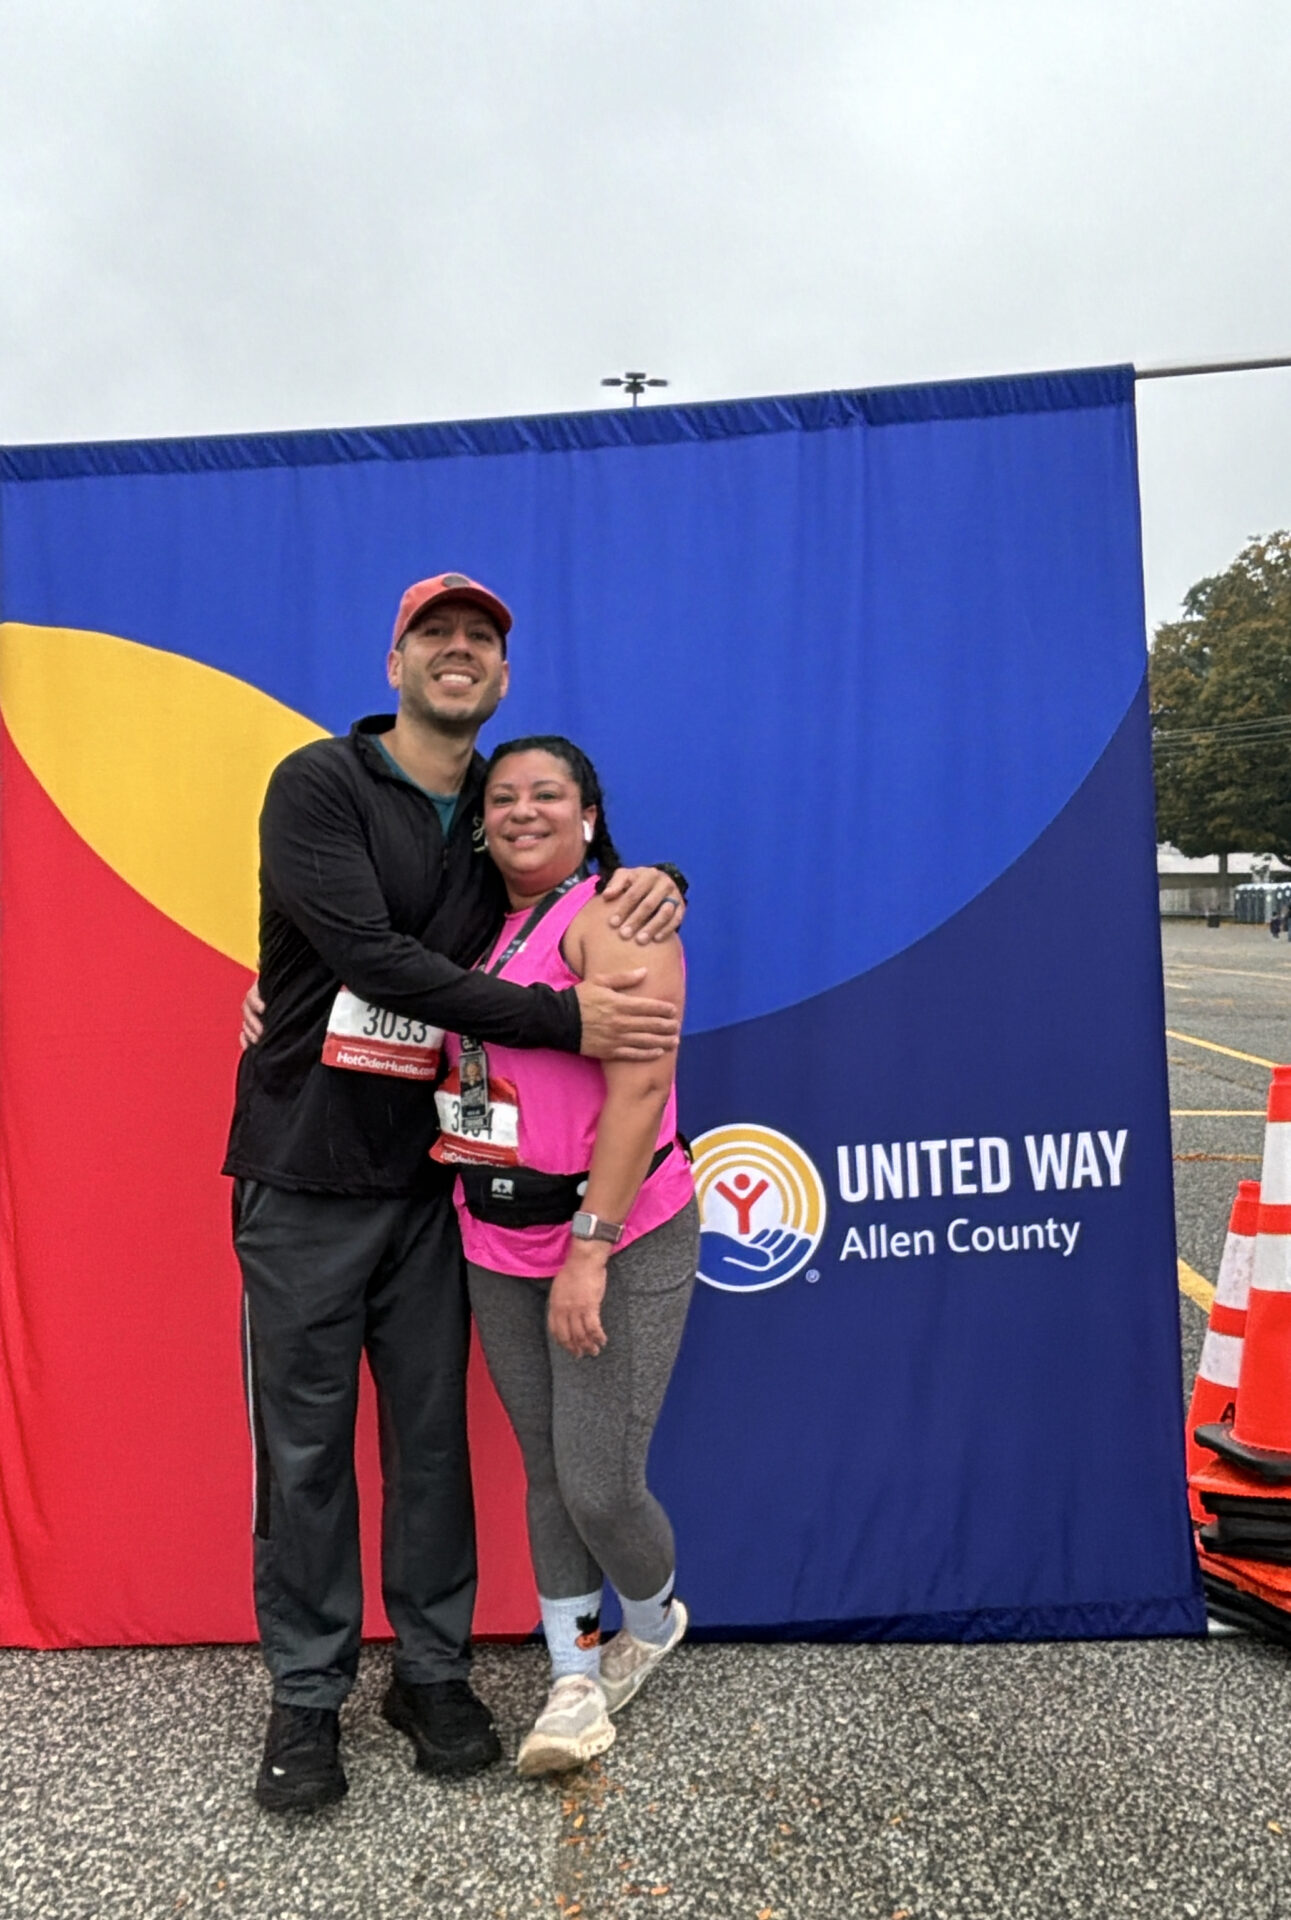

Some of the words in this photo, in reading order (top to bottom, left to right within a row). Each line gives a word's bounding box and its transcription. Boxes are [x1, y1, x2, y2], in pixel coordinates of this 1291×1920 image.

[363, 1004, 427, 1043] 3033
[336, 1051, 437, 1075] HotCiderHustle.com
[451, 1101, 494, 1140] 34
[837, 1137, 1012, 1202] UNITED
[1024, 1129, 1128, 1191] WAY
[840, 1224, 935, 1261] Allen
[947, 1217, 1081, 1256] County
